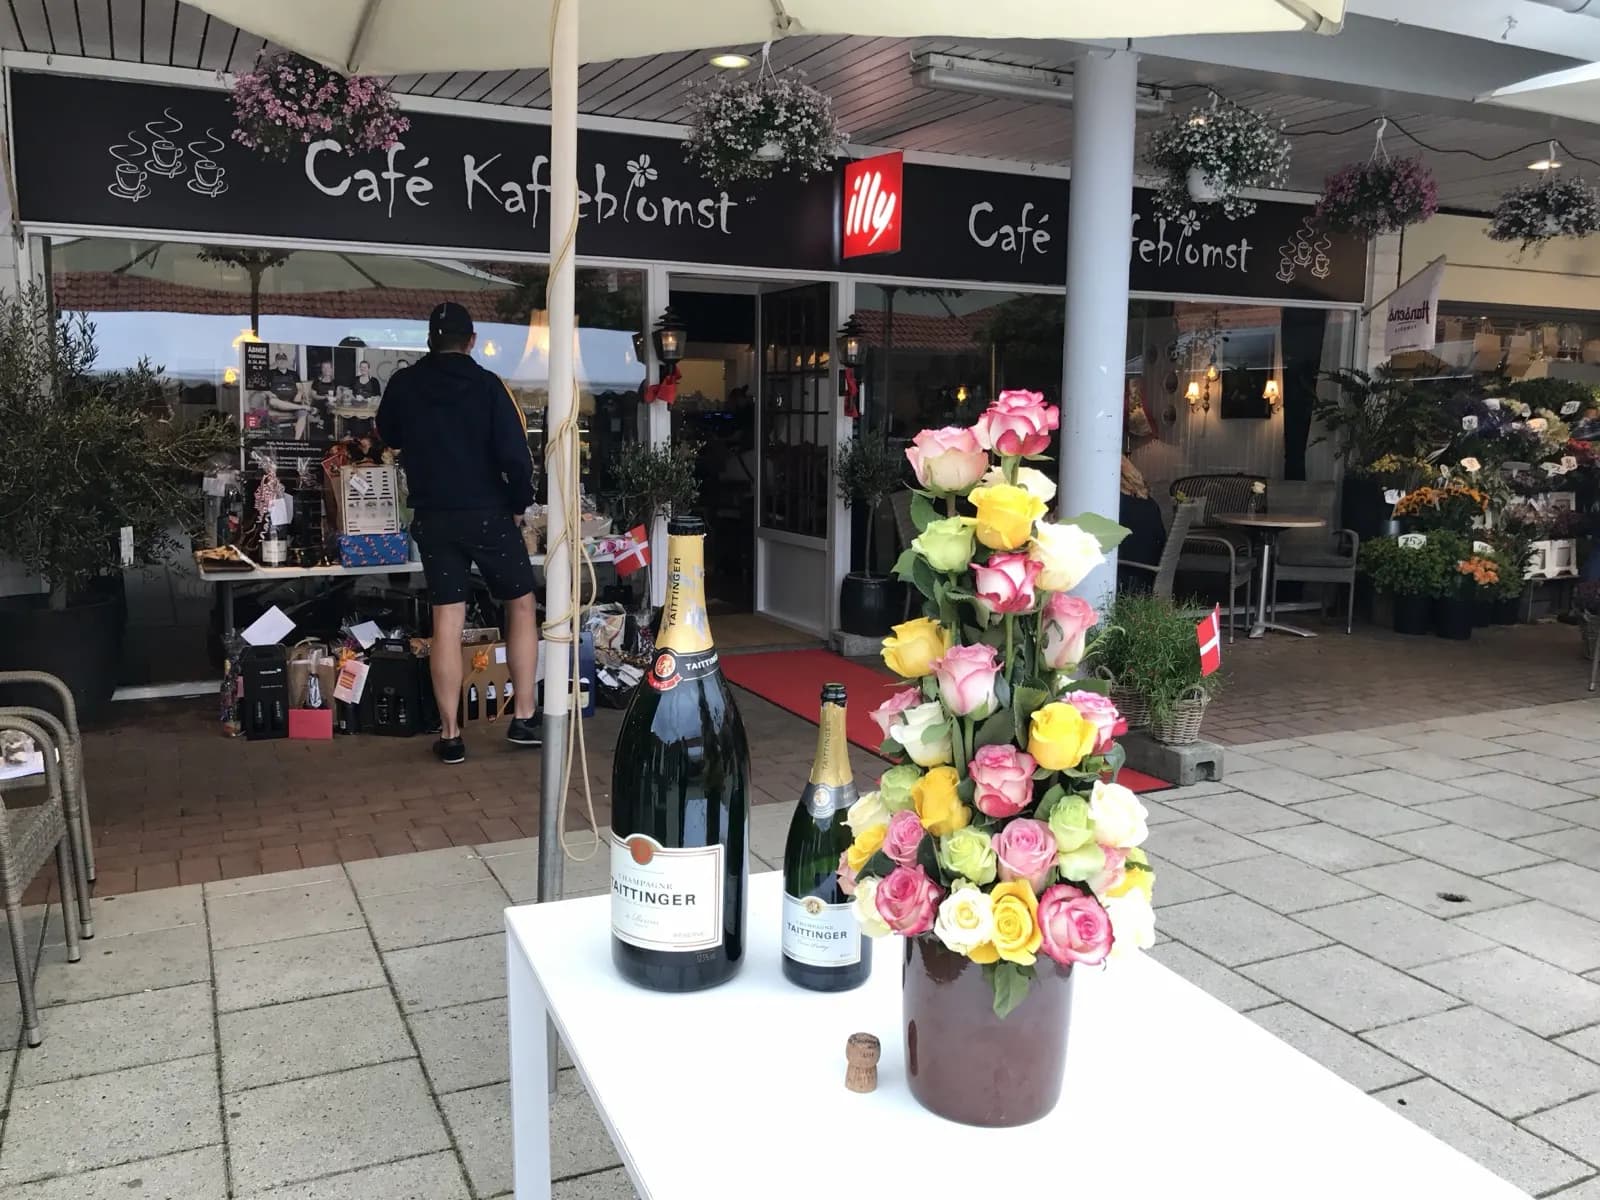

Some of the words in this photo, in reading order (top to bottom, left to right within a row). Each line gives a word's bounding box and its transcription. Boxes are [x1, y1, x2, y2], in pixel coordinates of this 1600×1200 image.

[305, 139, 433, 219] Café
[845, 170, 897, 248] illy
[968, 201, 1051, 265] Café
[668, 557, 681, 628] TAITTINGER
[787, 922, 848, 940] TAITTINGER
